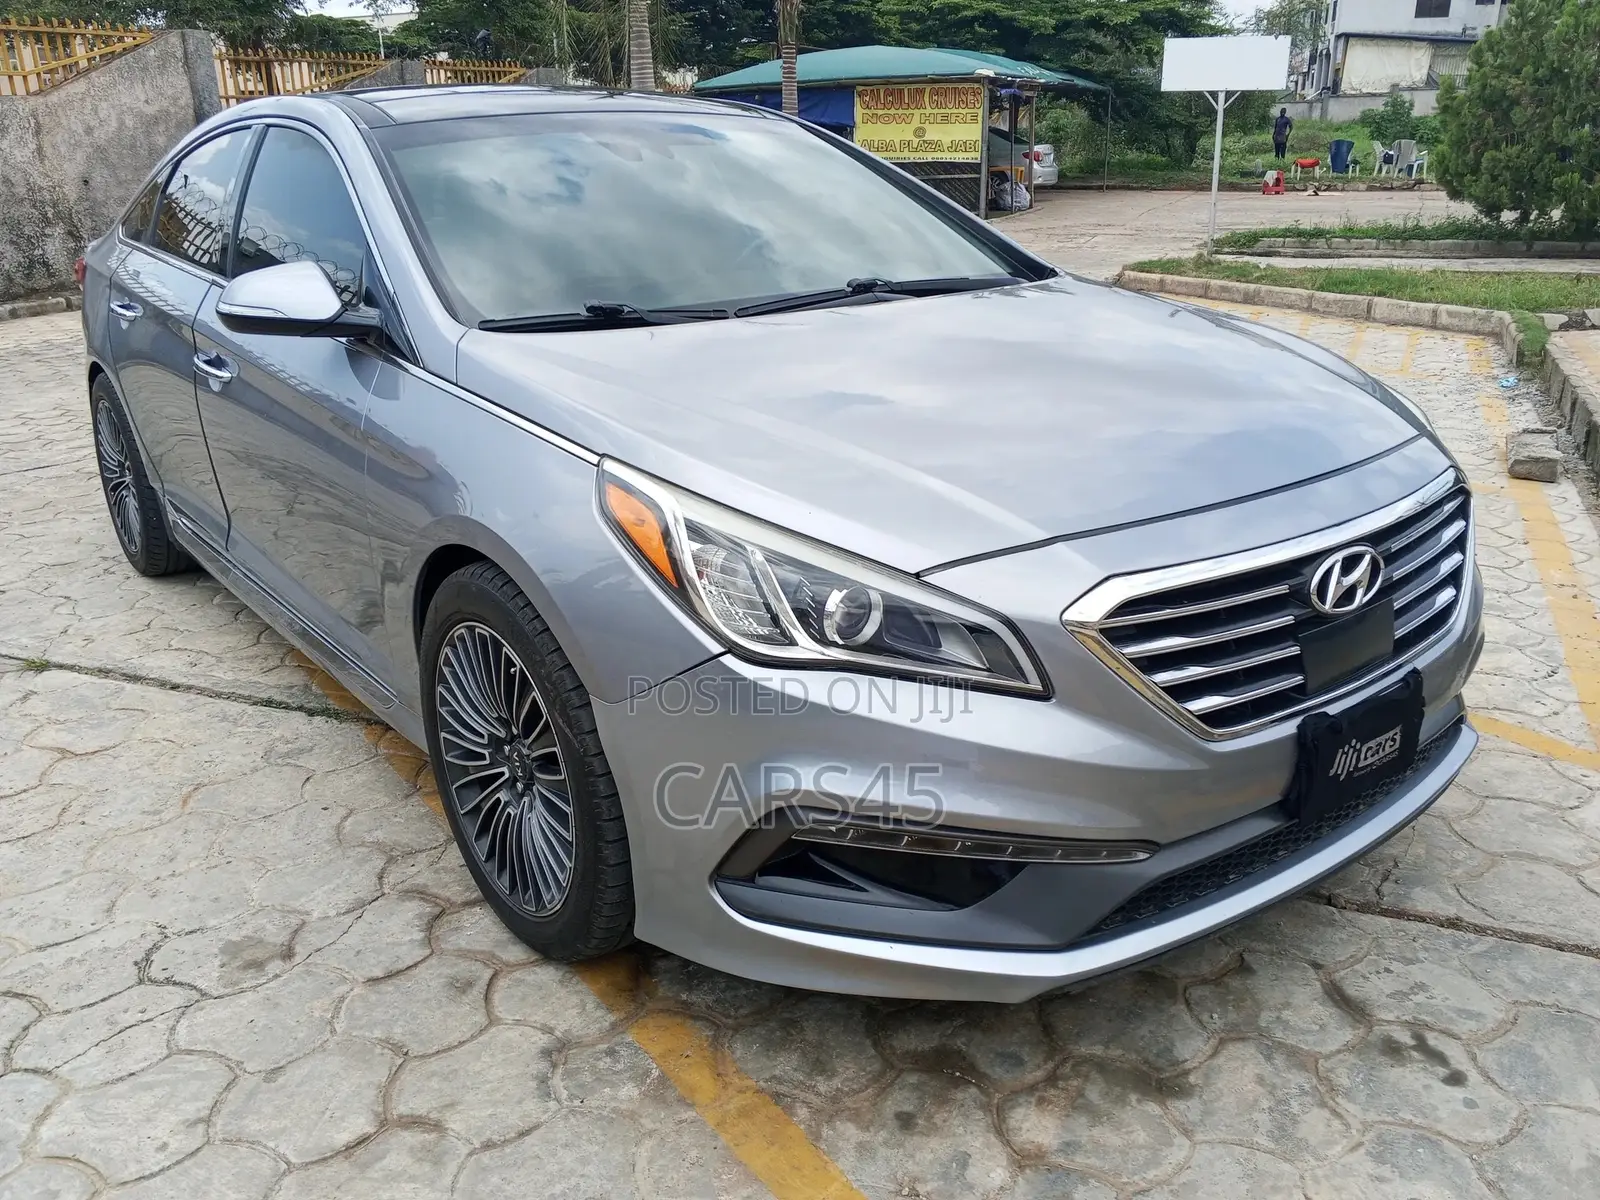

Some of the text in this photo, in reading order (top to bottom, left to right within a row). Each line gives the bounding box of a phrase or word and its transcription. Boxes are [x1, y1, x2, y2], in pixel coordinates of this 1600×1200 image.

[860, 86, 982, 110] CALCULUX CRUISES
[862, 113, 979, 124] NOW HERE
[913, 126, 927, 139] @
[861, 139, 980, 152] ALBA PLAZA JABI
[1328, 730, 1400, 781] Jiji cars
